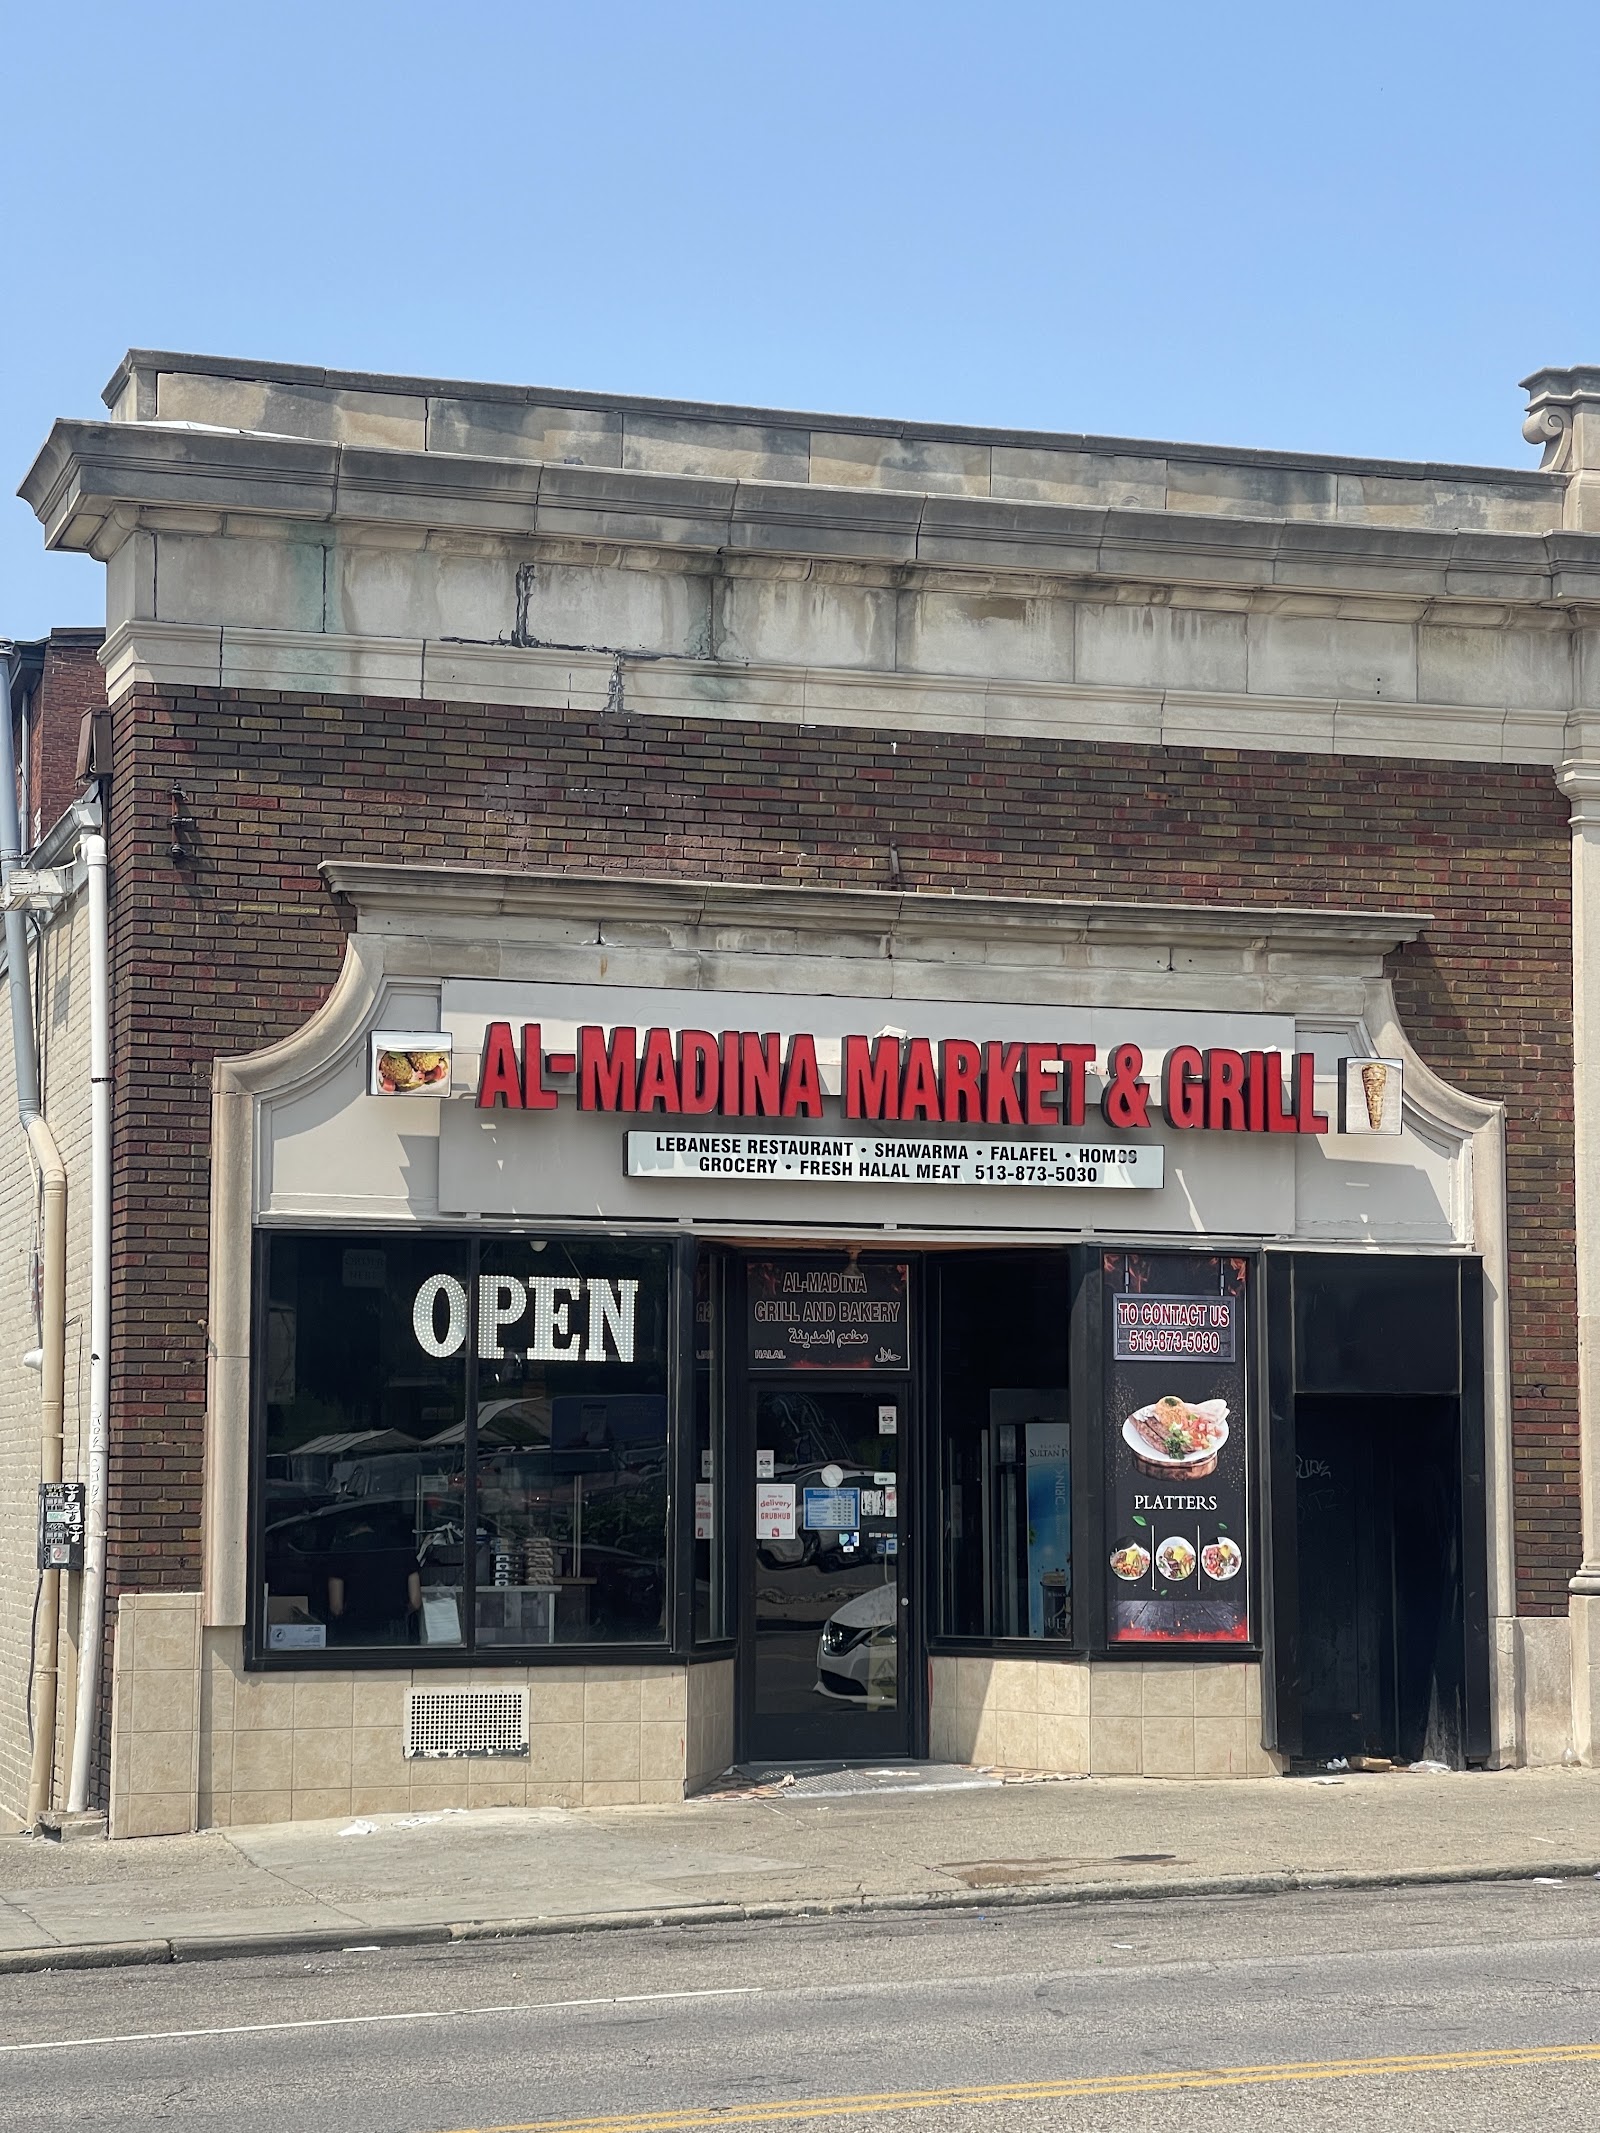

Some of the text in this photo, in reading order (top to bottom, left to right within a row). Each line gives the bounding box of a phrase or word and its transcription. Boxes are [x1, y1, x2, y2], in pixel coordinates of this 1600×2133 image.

[475, 1021, 1329, 1135] AL-MADINA MARKET & GRILL
[656, 1136, 741, 1154] LEBANESE
[747, 1139, 853, 1157] RESTAURANT
[874, 1143, 969, 1160] SHAWARMA
[990, 1146, 1058, 1162] FALAFEL
[699, 1156, 1098, 1182] GROCERY FRESH HALAL MEAT 513-873-5030
[783, 1272, 867, 1293] AL-MADINA
[412, 1273, 639, 1362] OPEN
[755, 1301, 901, 1322] GRILL AND BAKERY
[1119, 1303, 1230, 1327] TO CONTACT US
[788, 1327, 868, 1348] مطعم المدينة
[1129, 1330, 1220, 1354] 513-873-5030
[754, 1349, 787, 1360] HALAL
[874, 1346, 902, 1363] حلال
[1029, 1448, 1060, 1458] SULTAN
[760, 1499, 792, 1509] delivery
[1134, 1495, 1218, 1511] PLATTERS
[760, 1512, 791, 1520] GRUBHUB
